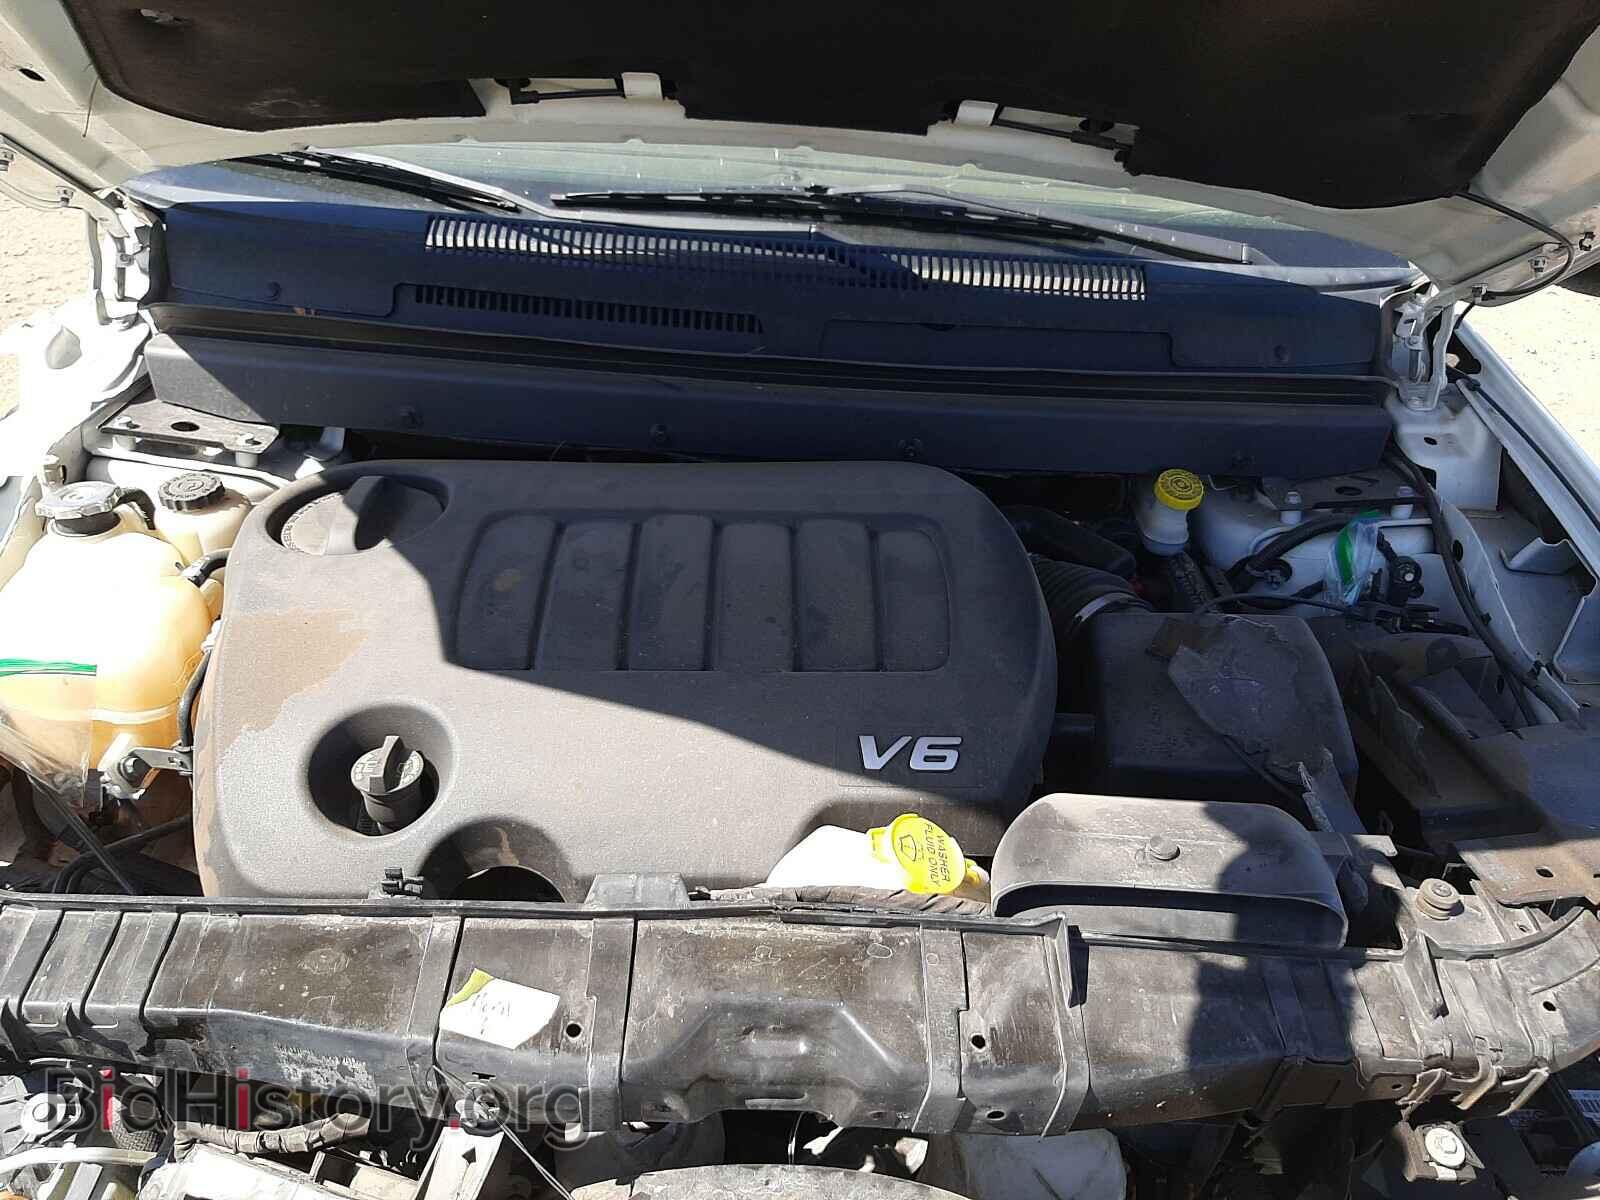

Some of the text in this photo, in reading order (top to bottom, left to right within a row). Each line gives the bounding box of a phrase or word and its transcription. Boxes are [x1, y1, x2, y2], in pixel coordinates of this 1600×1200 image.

[858, 735, 962, 771] V6
[923, 821, 942, 888] FLUID ONLY
[935, 834, 952, 883] WASHER
